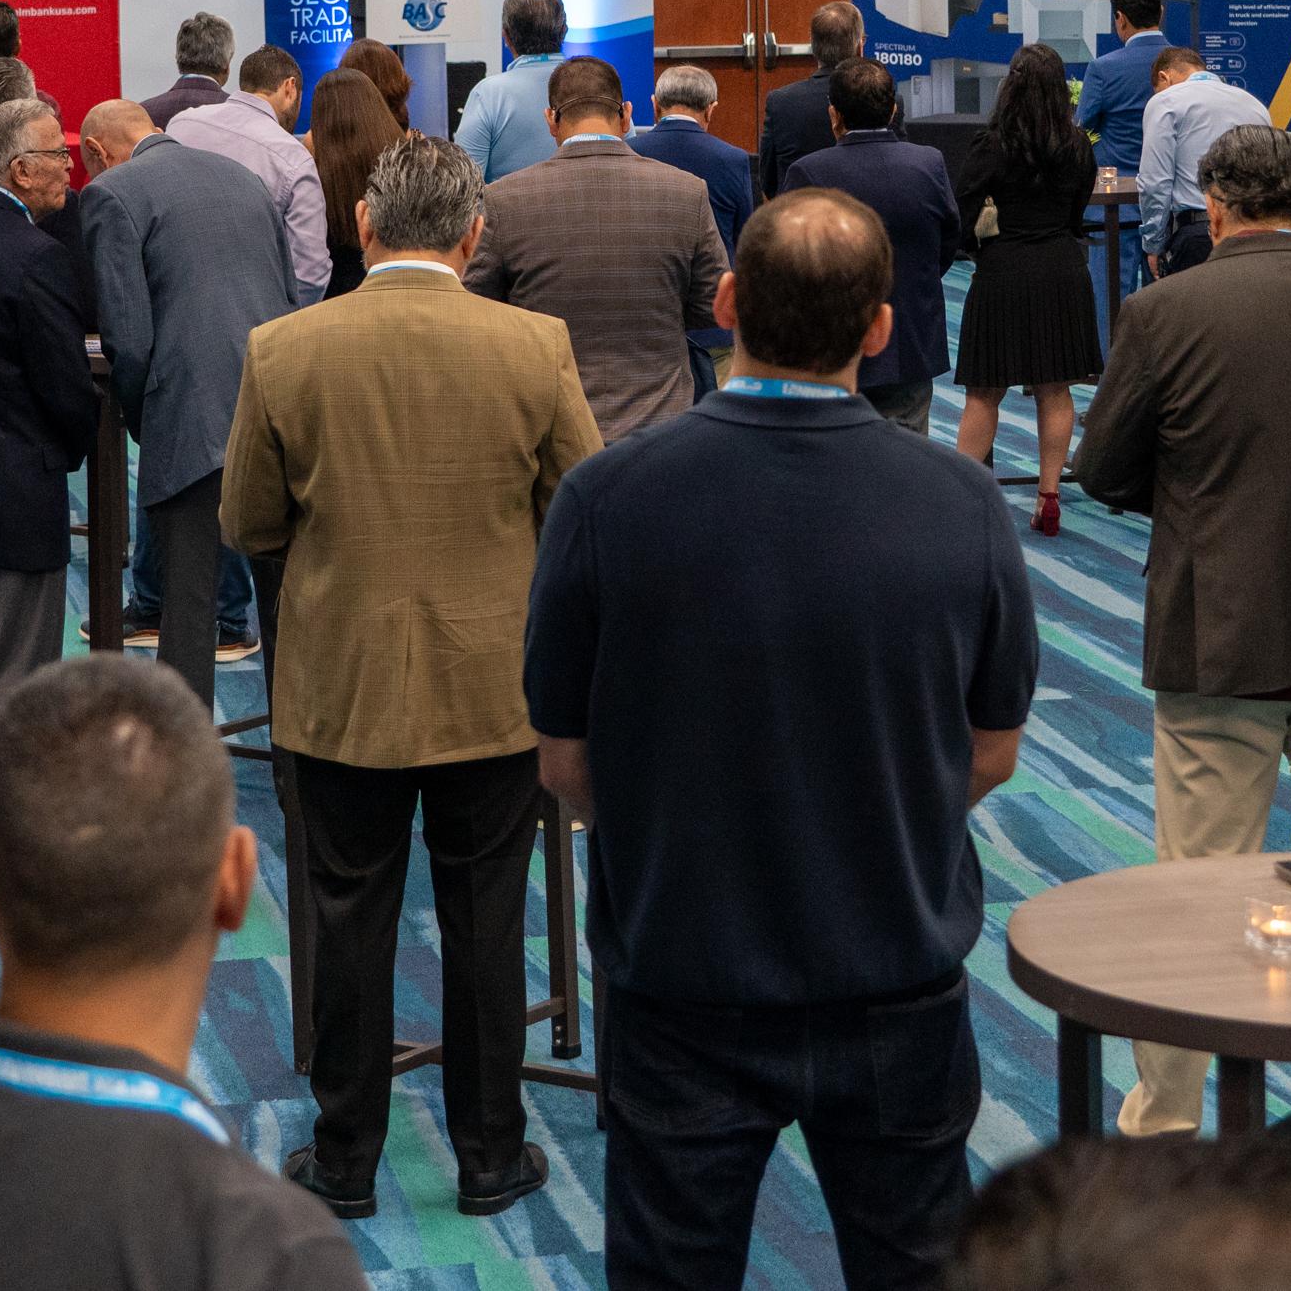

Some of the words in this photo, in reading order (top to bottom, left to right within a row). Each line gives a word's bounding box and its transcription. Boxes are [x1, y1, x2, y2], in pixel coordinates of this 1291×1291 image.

[290, 6, 352, 28] TRAD
[874, 41, 916, 51] SPECTRUM
[874, 51, 923, 67] 180180
